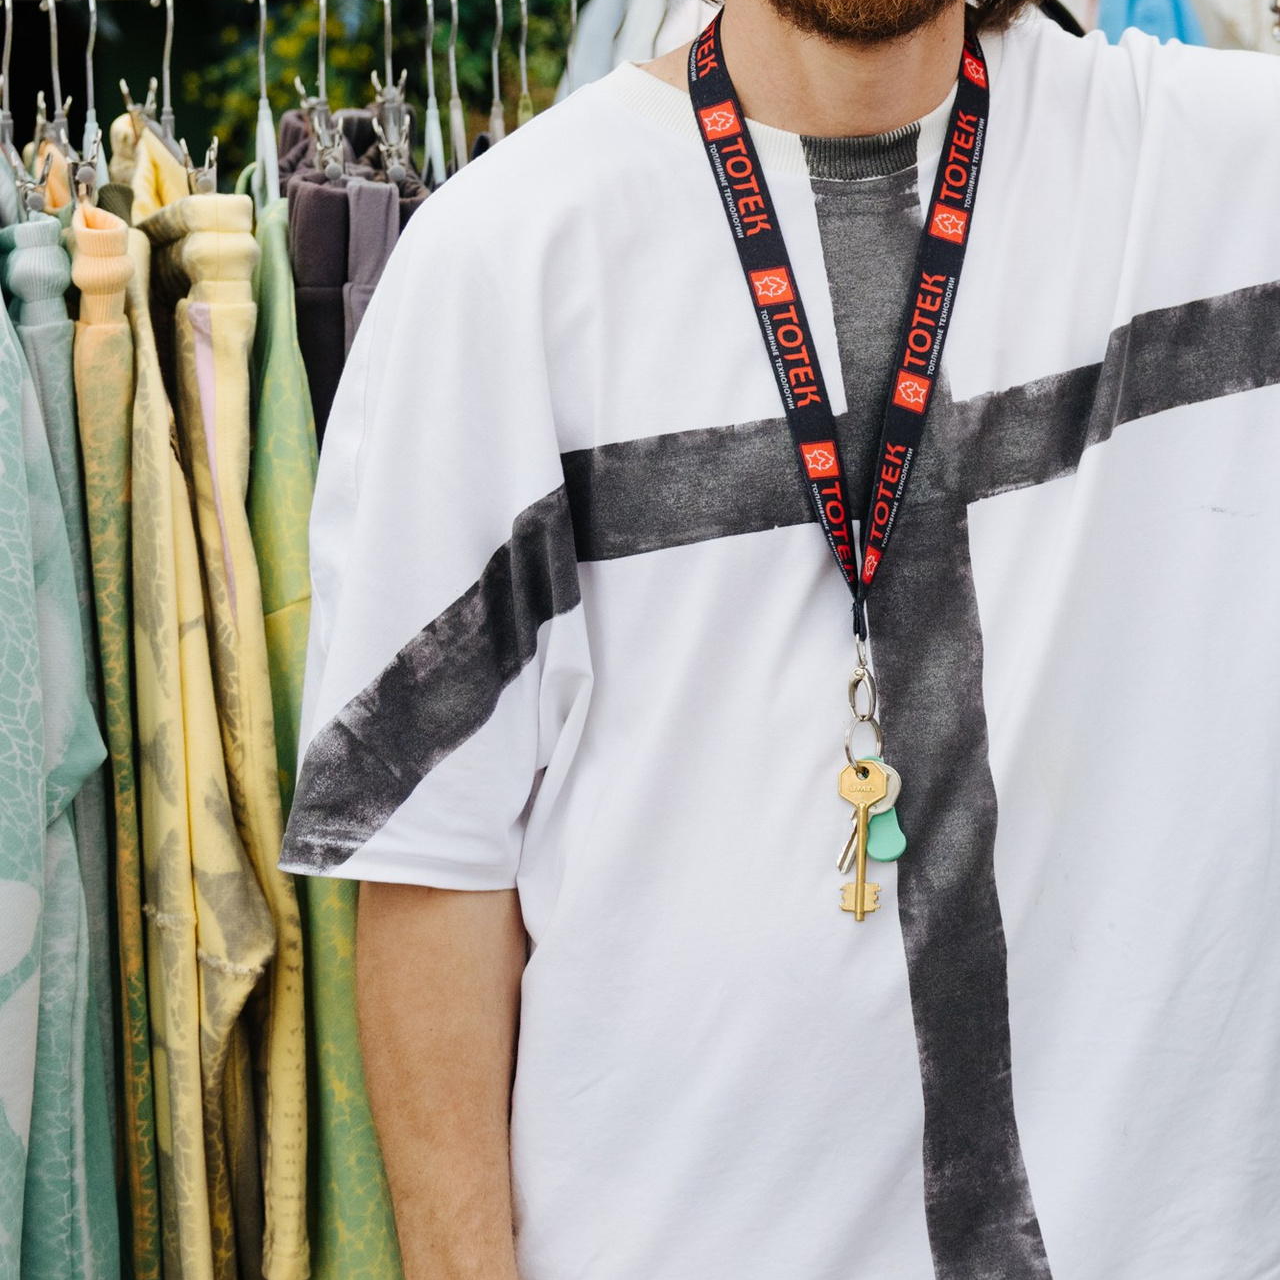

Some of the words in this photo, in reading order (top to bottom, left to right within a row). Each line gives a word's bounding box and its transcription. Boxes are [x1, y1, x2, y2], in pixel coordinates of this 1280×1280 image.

[708, 143, 729, 187] ТОПЛИВНЫЕ
[723, 187, 744, 239] ТЕХНОЛОГИИ
[721, 136, 772, 237] ТОТЕК
[940, 108, 978, 202] ТОТЕК
[964, 167, 979, 209] ТОПЛИВНЫЕ
[972, 118, 985, 165] ТЕХНОЛОГИИ
[760, 309, 779, 356] ТОПЛИВНЫЕ
[774, 357, 795, 410] ТЕХНОЛОГИИ
[772, 304, 822, 409] ТОТЕК
[903, 270, 947, 368] ТОТЕК
[927, 329, 944, 376] ТОПЛИВНЫЕ
[938, 277, 956, 327] ТЕХНОЛОГИИ
[869, 441, 907, 542] ТОТЕК
